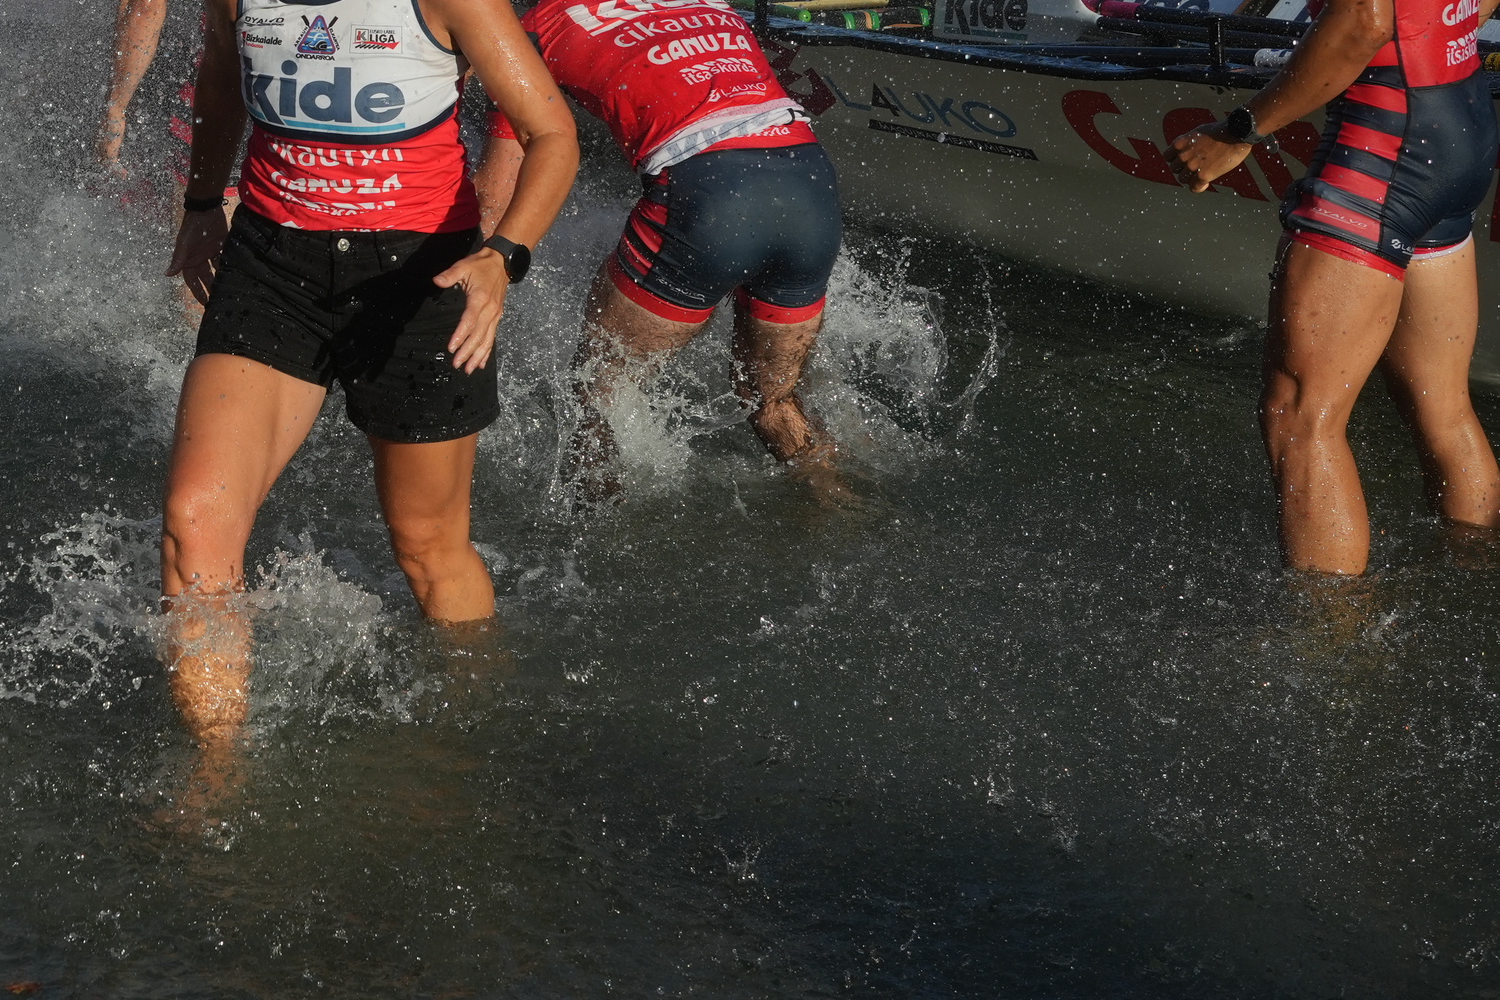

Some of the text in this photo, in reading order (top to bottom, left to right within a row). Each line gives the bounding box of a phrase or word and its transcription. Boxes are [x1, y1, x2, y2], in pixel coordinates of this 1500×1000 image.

[369, 34, 396, 44] LIGA
[647, 32, 753, 65] GANUZA
[295, 53, 336, 61] ONDARROA
[681, 62, 759, 86] itsaskorda
[243, 56, 406, 126] kide
